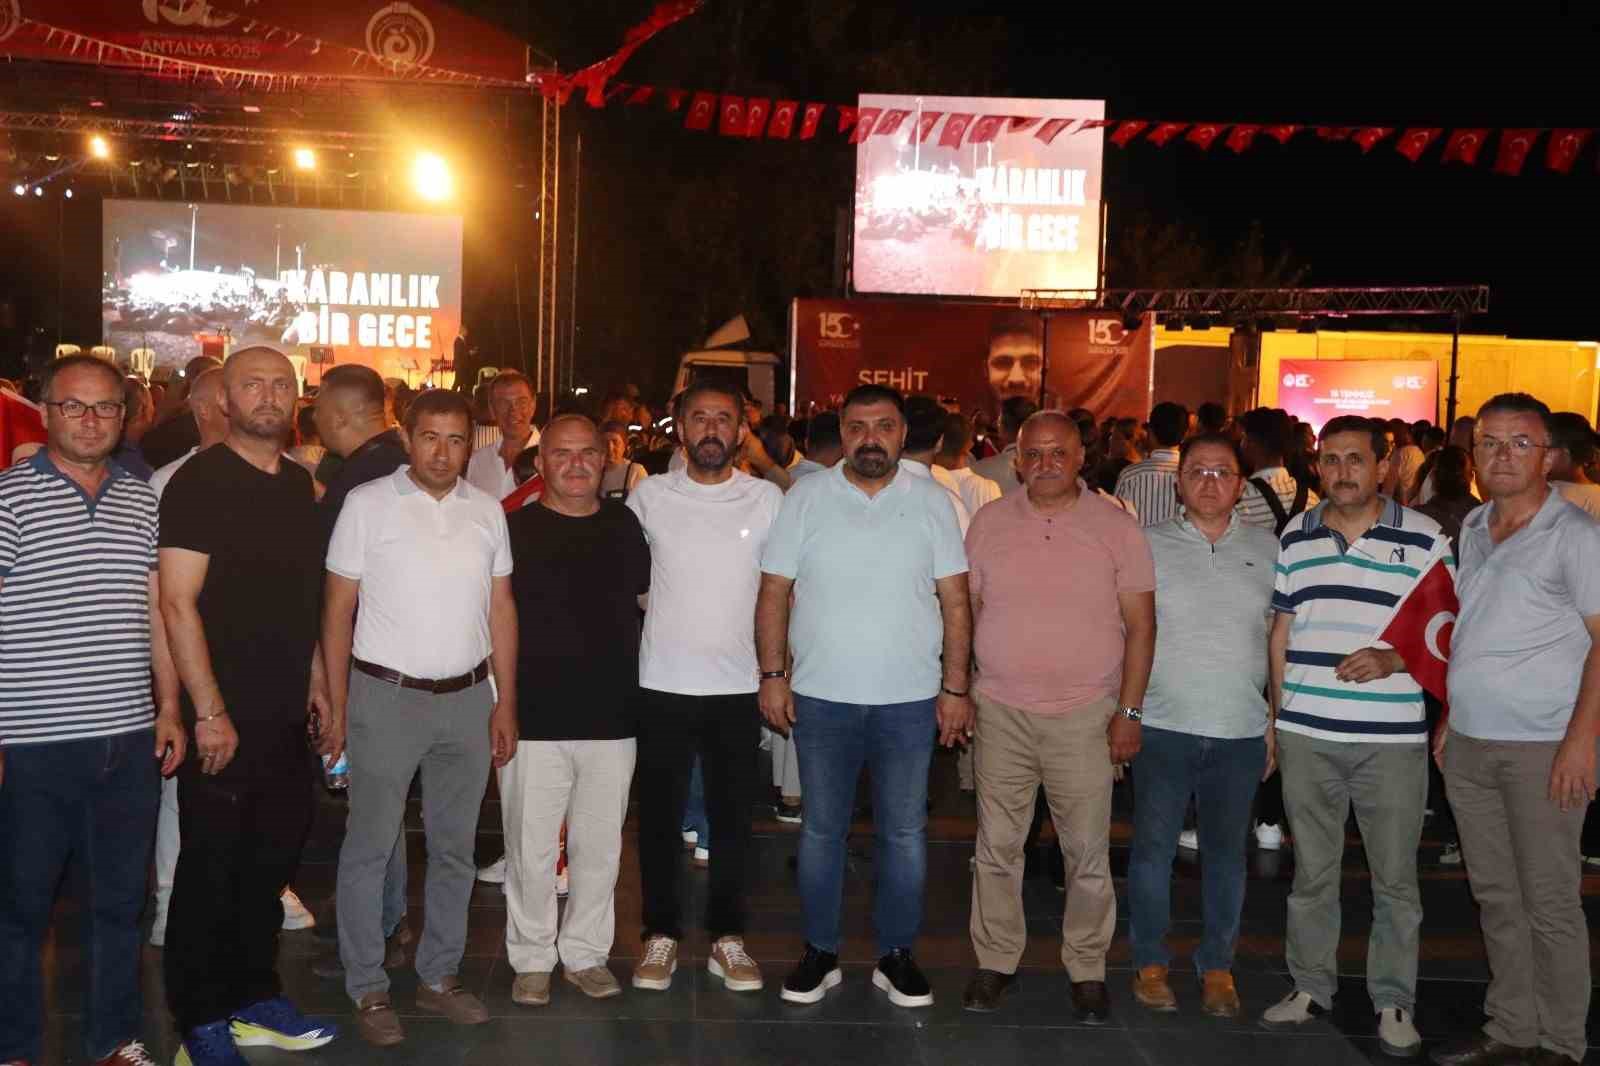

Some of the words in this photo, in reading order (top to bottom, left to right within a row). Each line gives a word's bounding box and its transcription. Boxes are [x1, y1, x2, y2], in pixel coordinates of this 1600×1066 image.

[141, 40, 216, 57] ANTALYA
[286, 269, 440, 308] KARANLIK
[299, 304, 350, 345] BİR
[359, 312, 432, 348] GECE
